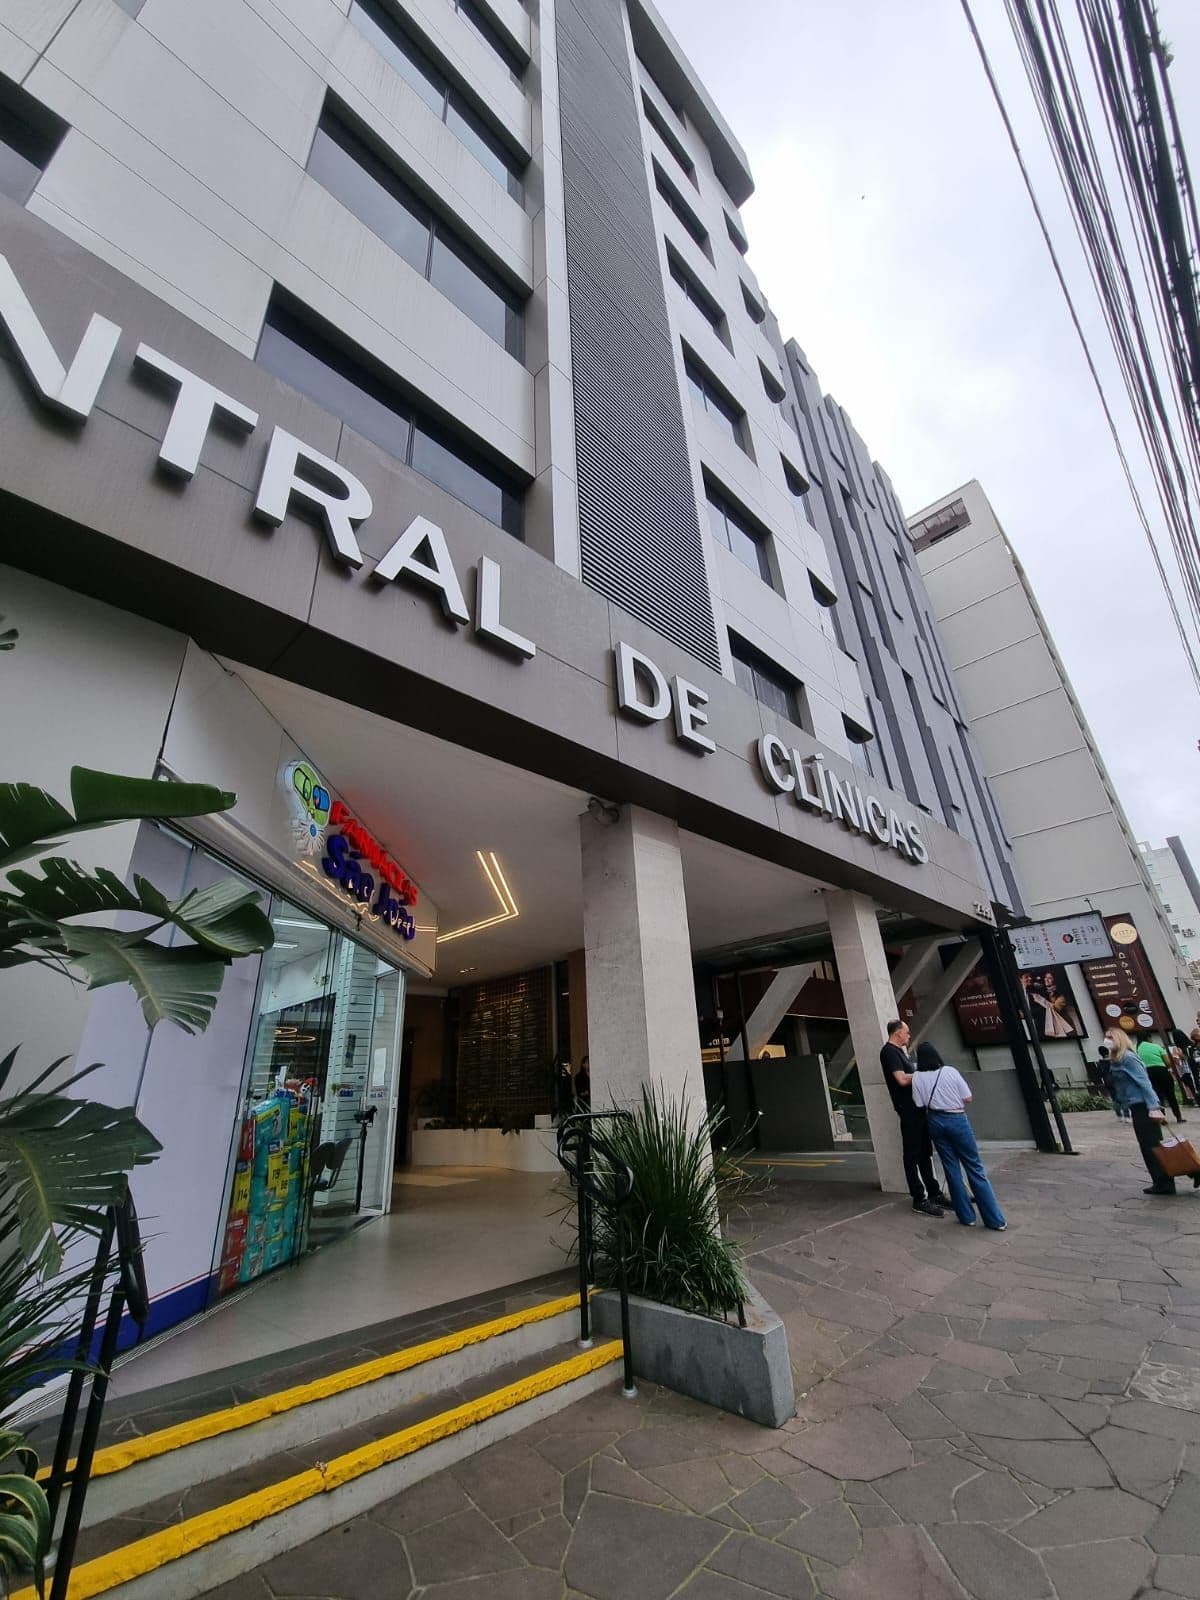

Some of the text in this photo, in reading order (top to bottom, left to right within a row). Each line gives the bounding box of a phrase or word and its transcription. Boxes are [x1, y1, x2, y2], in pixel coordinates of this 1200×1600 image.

[614, 641, 717, 755] DE
[757, 732, 929, 866] CLÍNICAS
[970, 1015, 1004, 1026] VITTA
